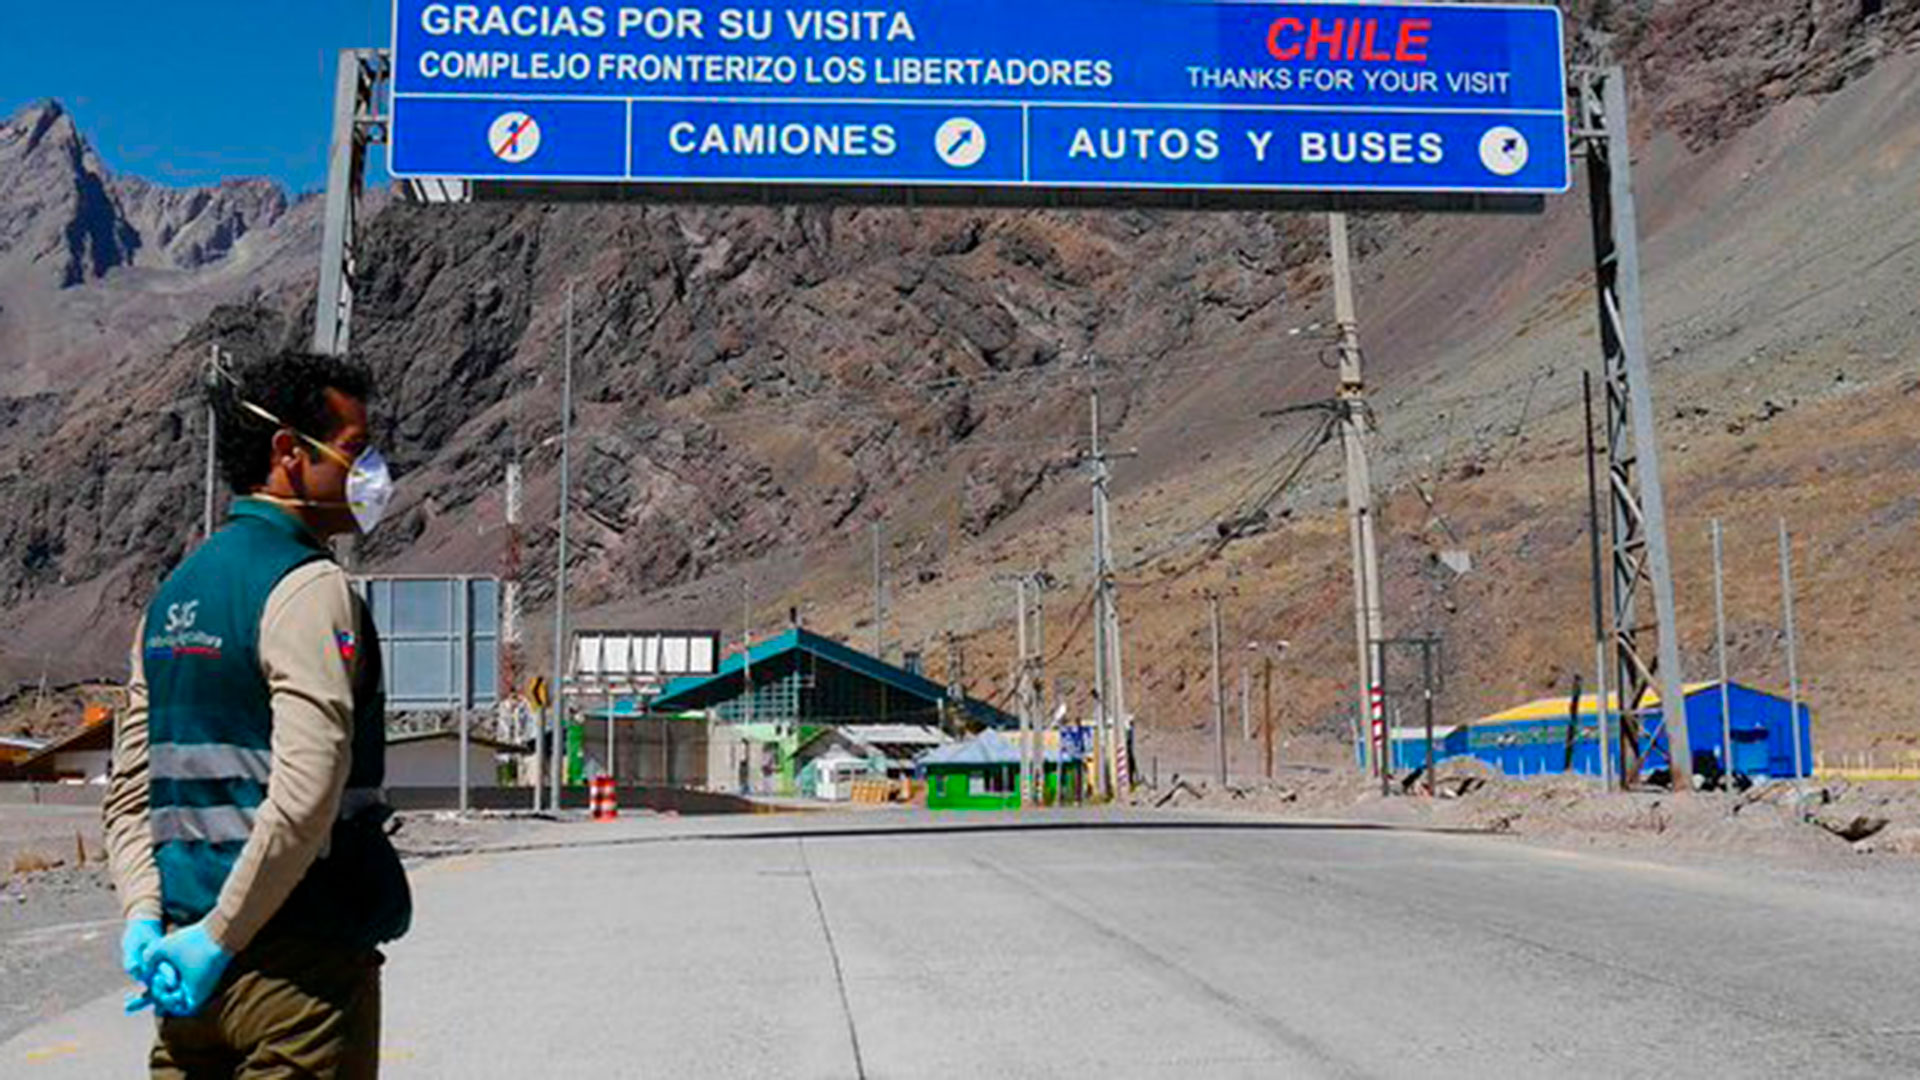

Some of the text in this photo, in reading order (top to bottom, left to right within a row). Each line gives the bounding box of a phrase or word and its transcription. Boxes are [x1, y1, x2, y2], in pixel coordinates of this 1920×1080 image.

[421, 4, 915, 41] GRACIAS POR SU VISITA
[1266, 17, 1430, 62] CHILE
[419, 51, 1112, 87] COMPLEJO FRONTERIZO LOS LIBERTADORES
[1187, 67, 1511, 93] THANKS FOR YOUR VISIT
[669, 122, 896, 155] CAMIONES
[1069, 128, 1443, 163] AUTOS Y BUSES
